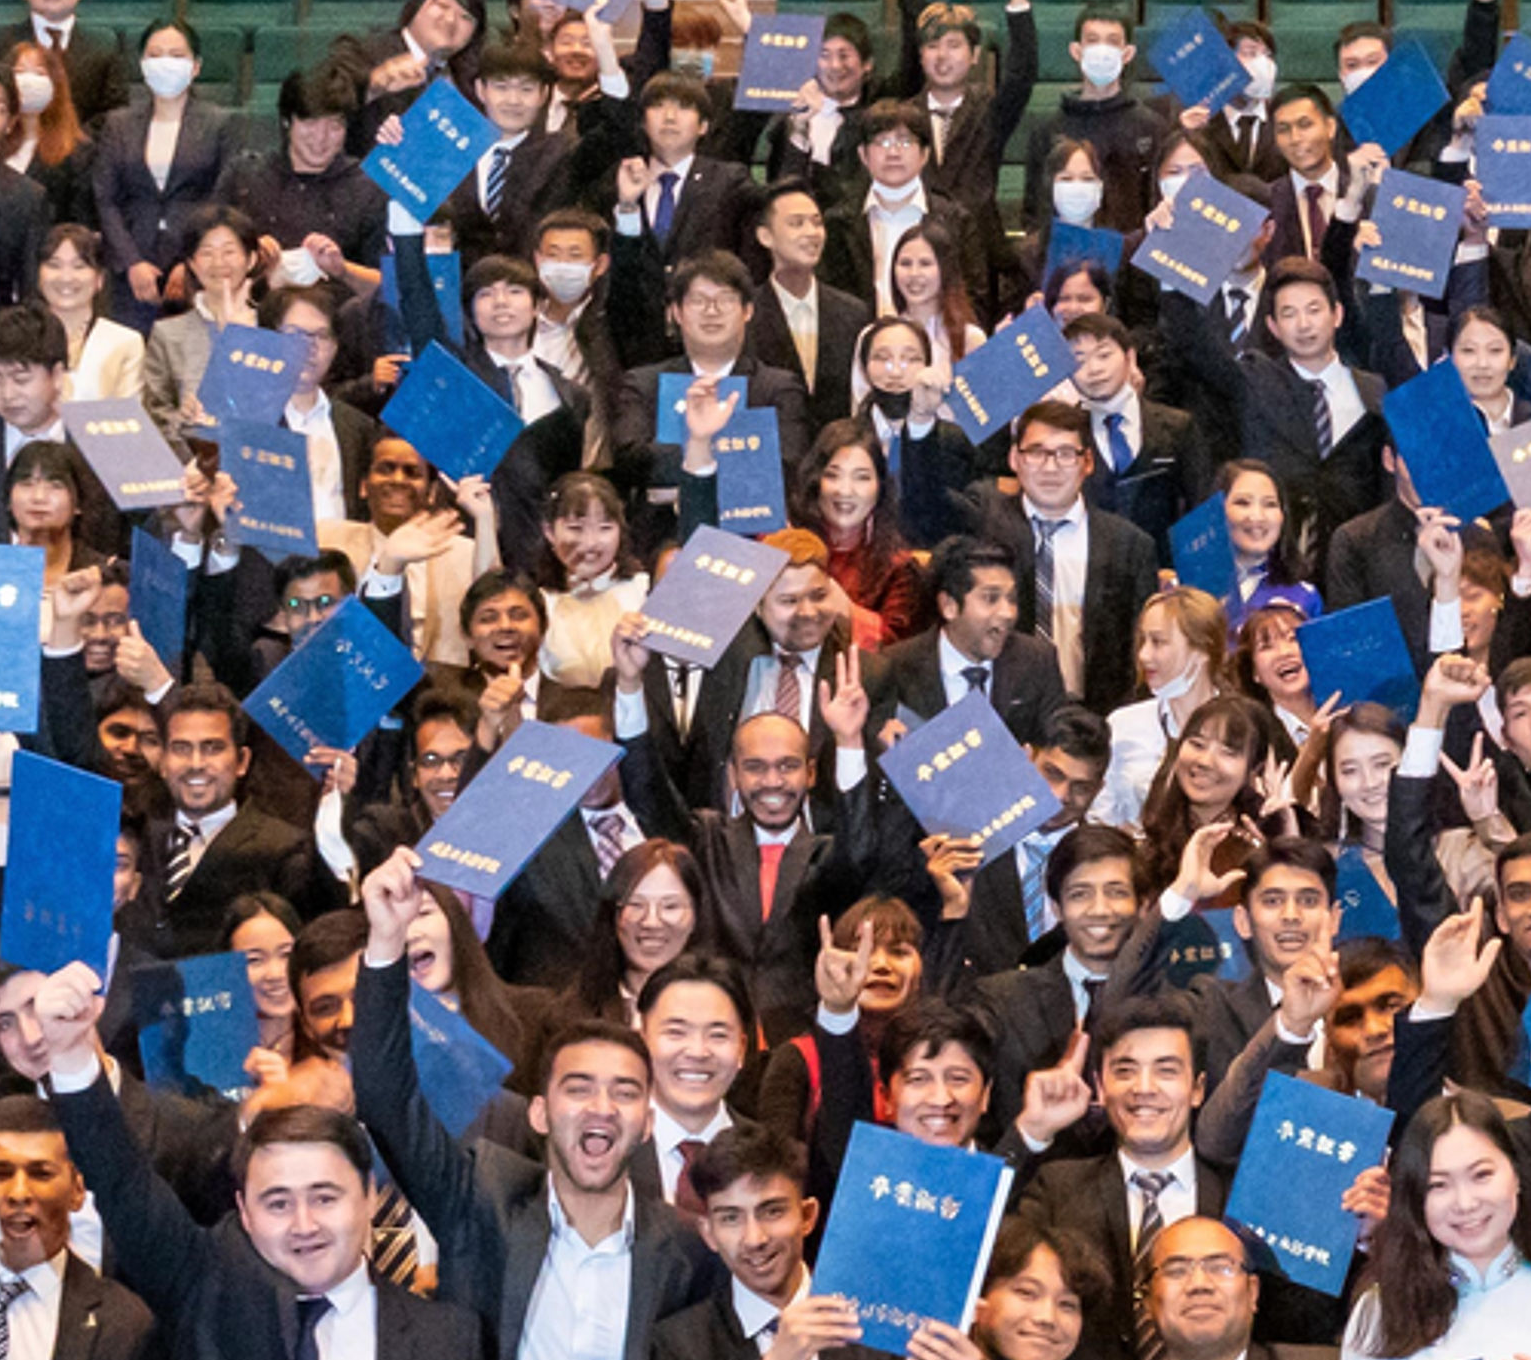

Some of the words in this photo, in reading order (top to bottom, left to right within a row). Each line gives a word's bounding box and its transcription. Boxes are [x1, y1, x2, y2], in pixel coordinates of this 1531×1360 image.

[1247, 1223, 1330, 1266] 東日本語学校
